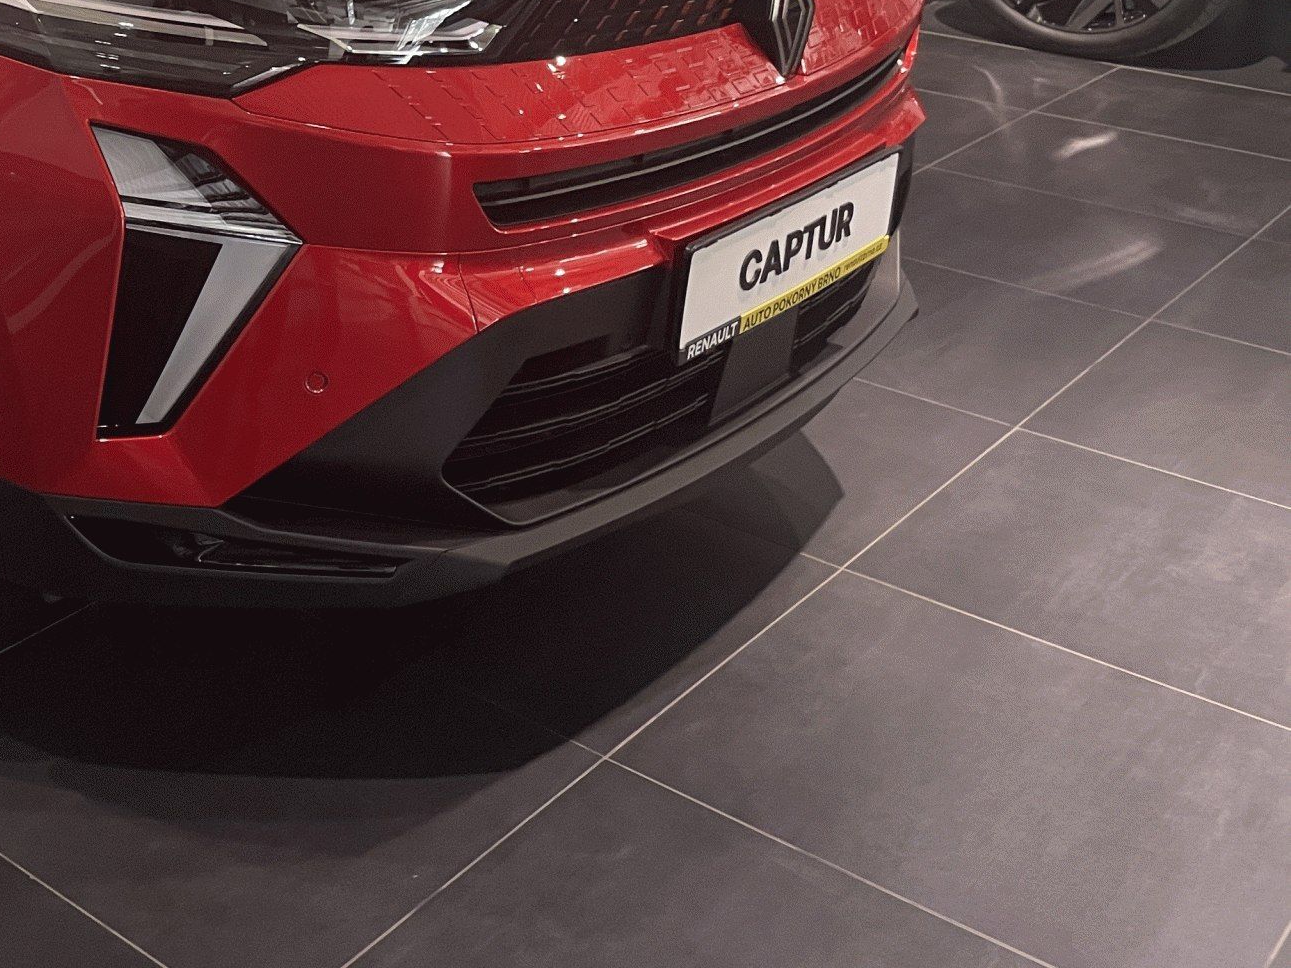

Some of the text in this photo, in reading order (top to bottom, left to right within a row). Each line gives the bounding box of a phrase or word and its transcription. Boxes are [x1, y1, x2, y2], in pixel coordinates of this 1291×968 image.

[739, 201, 854, 291] CAPTUR
[687, 321, 738, 360] RENAULT
[743, 307, 772, 331] AUTO
[818, 267, 841, 290] BRNO
